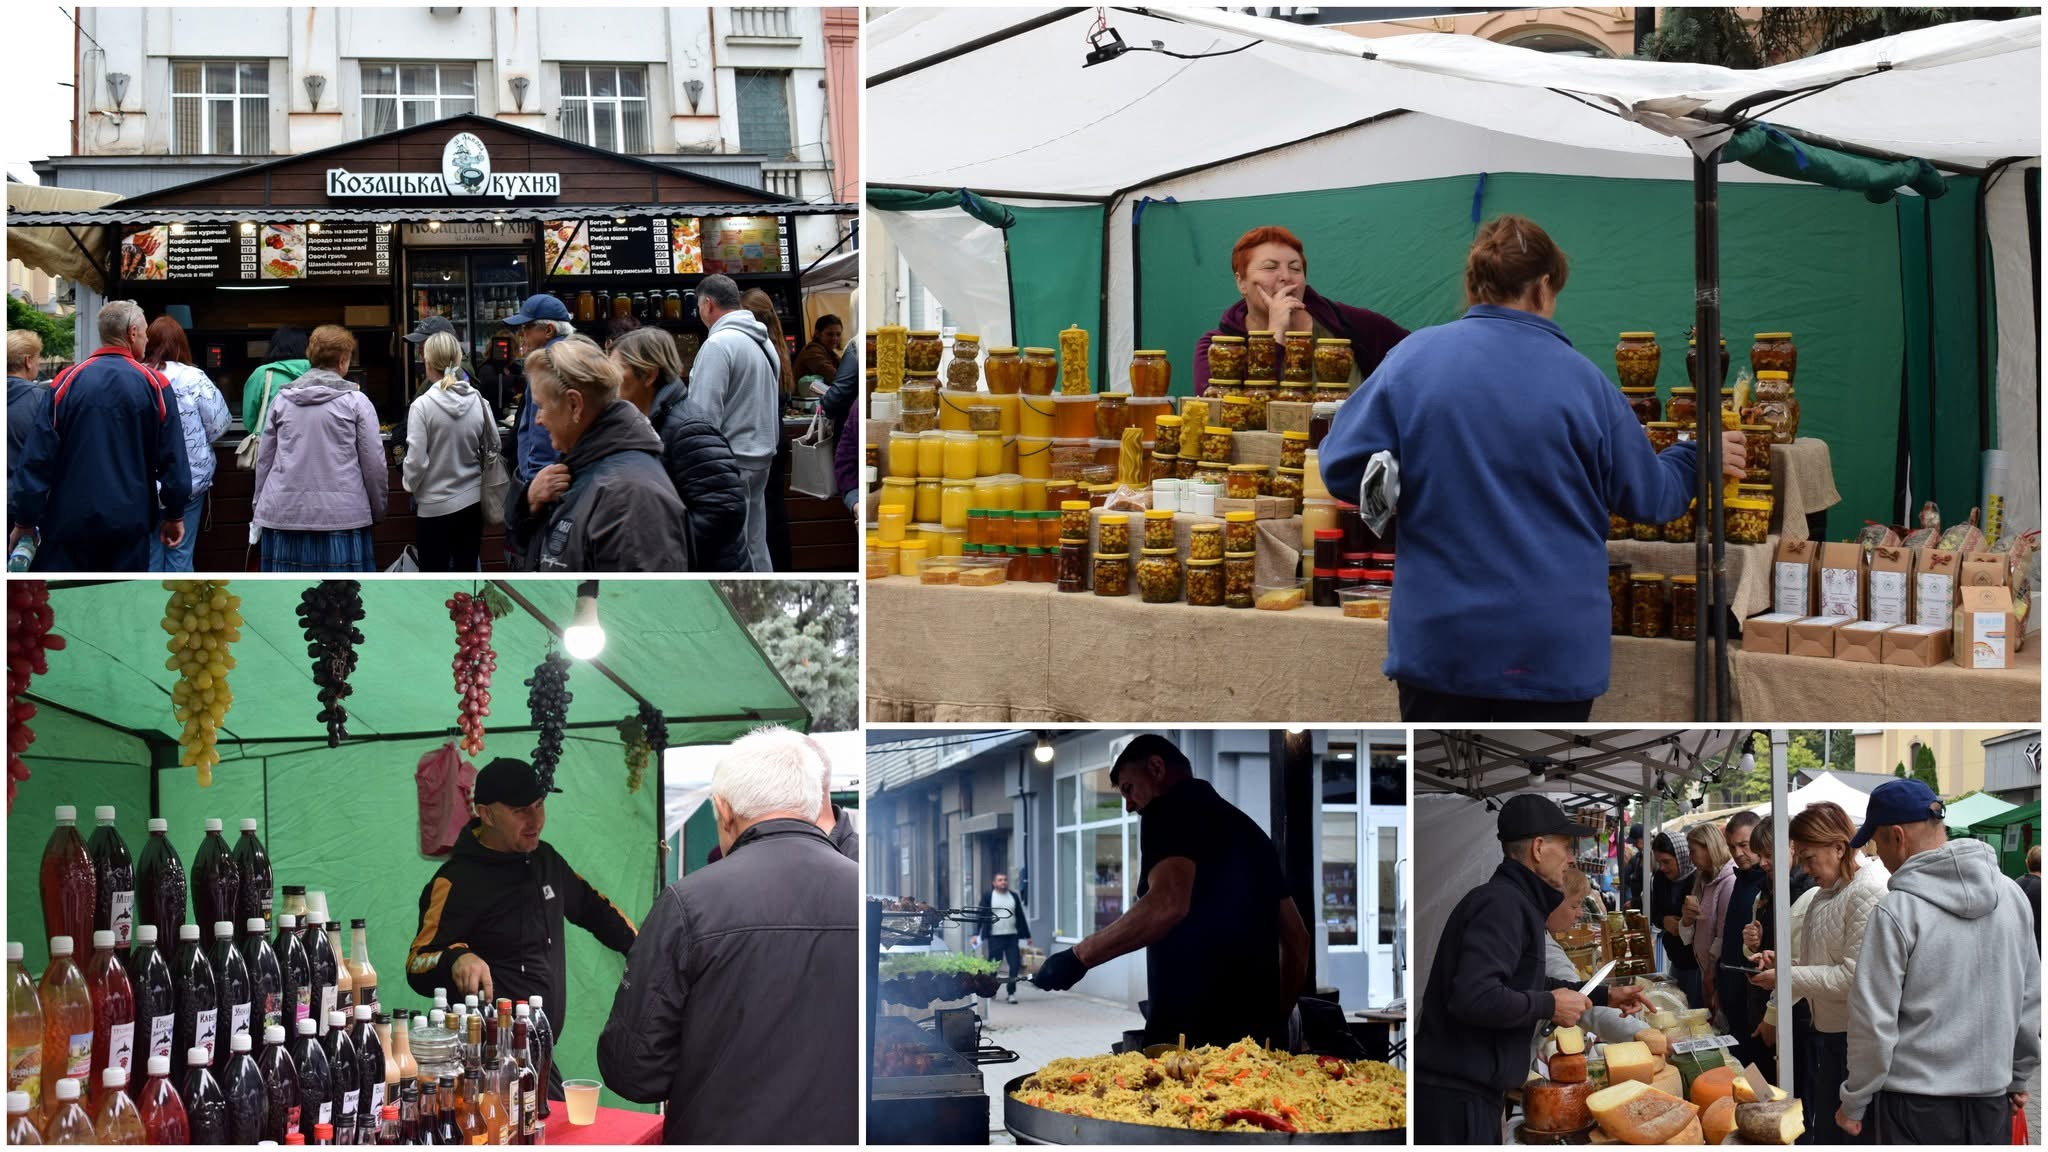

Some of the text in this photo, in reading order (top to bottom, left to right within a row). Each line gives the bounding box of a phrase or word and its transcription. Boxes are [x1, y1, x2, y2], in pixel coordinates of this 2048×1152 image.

[330, 171, 557, 197] Козацька кухня
[201, 237, 231, 245] домашні
[169, 246, 190, 254] Ребра
